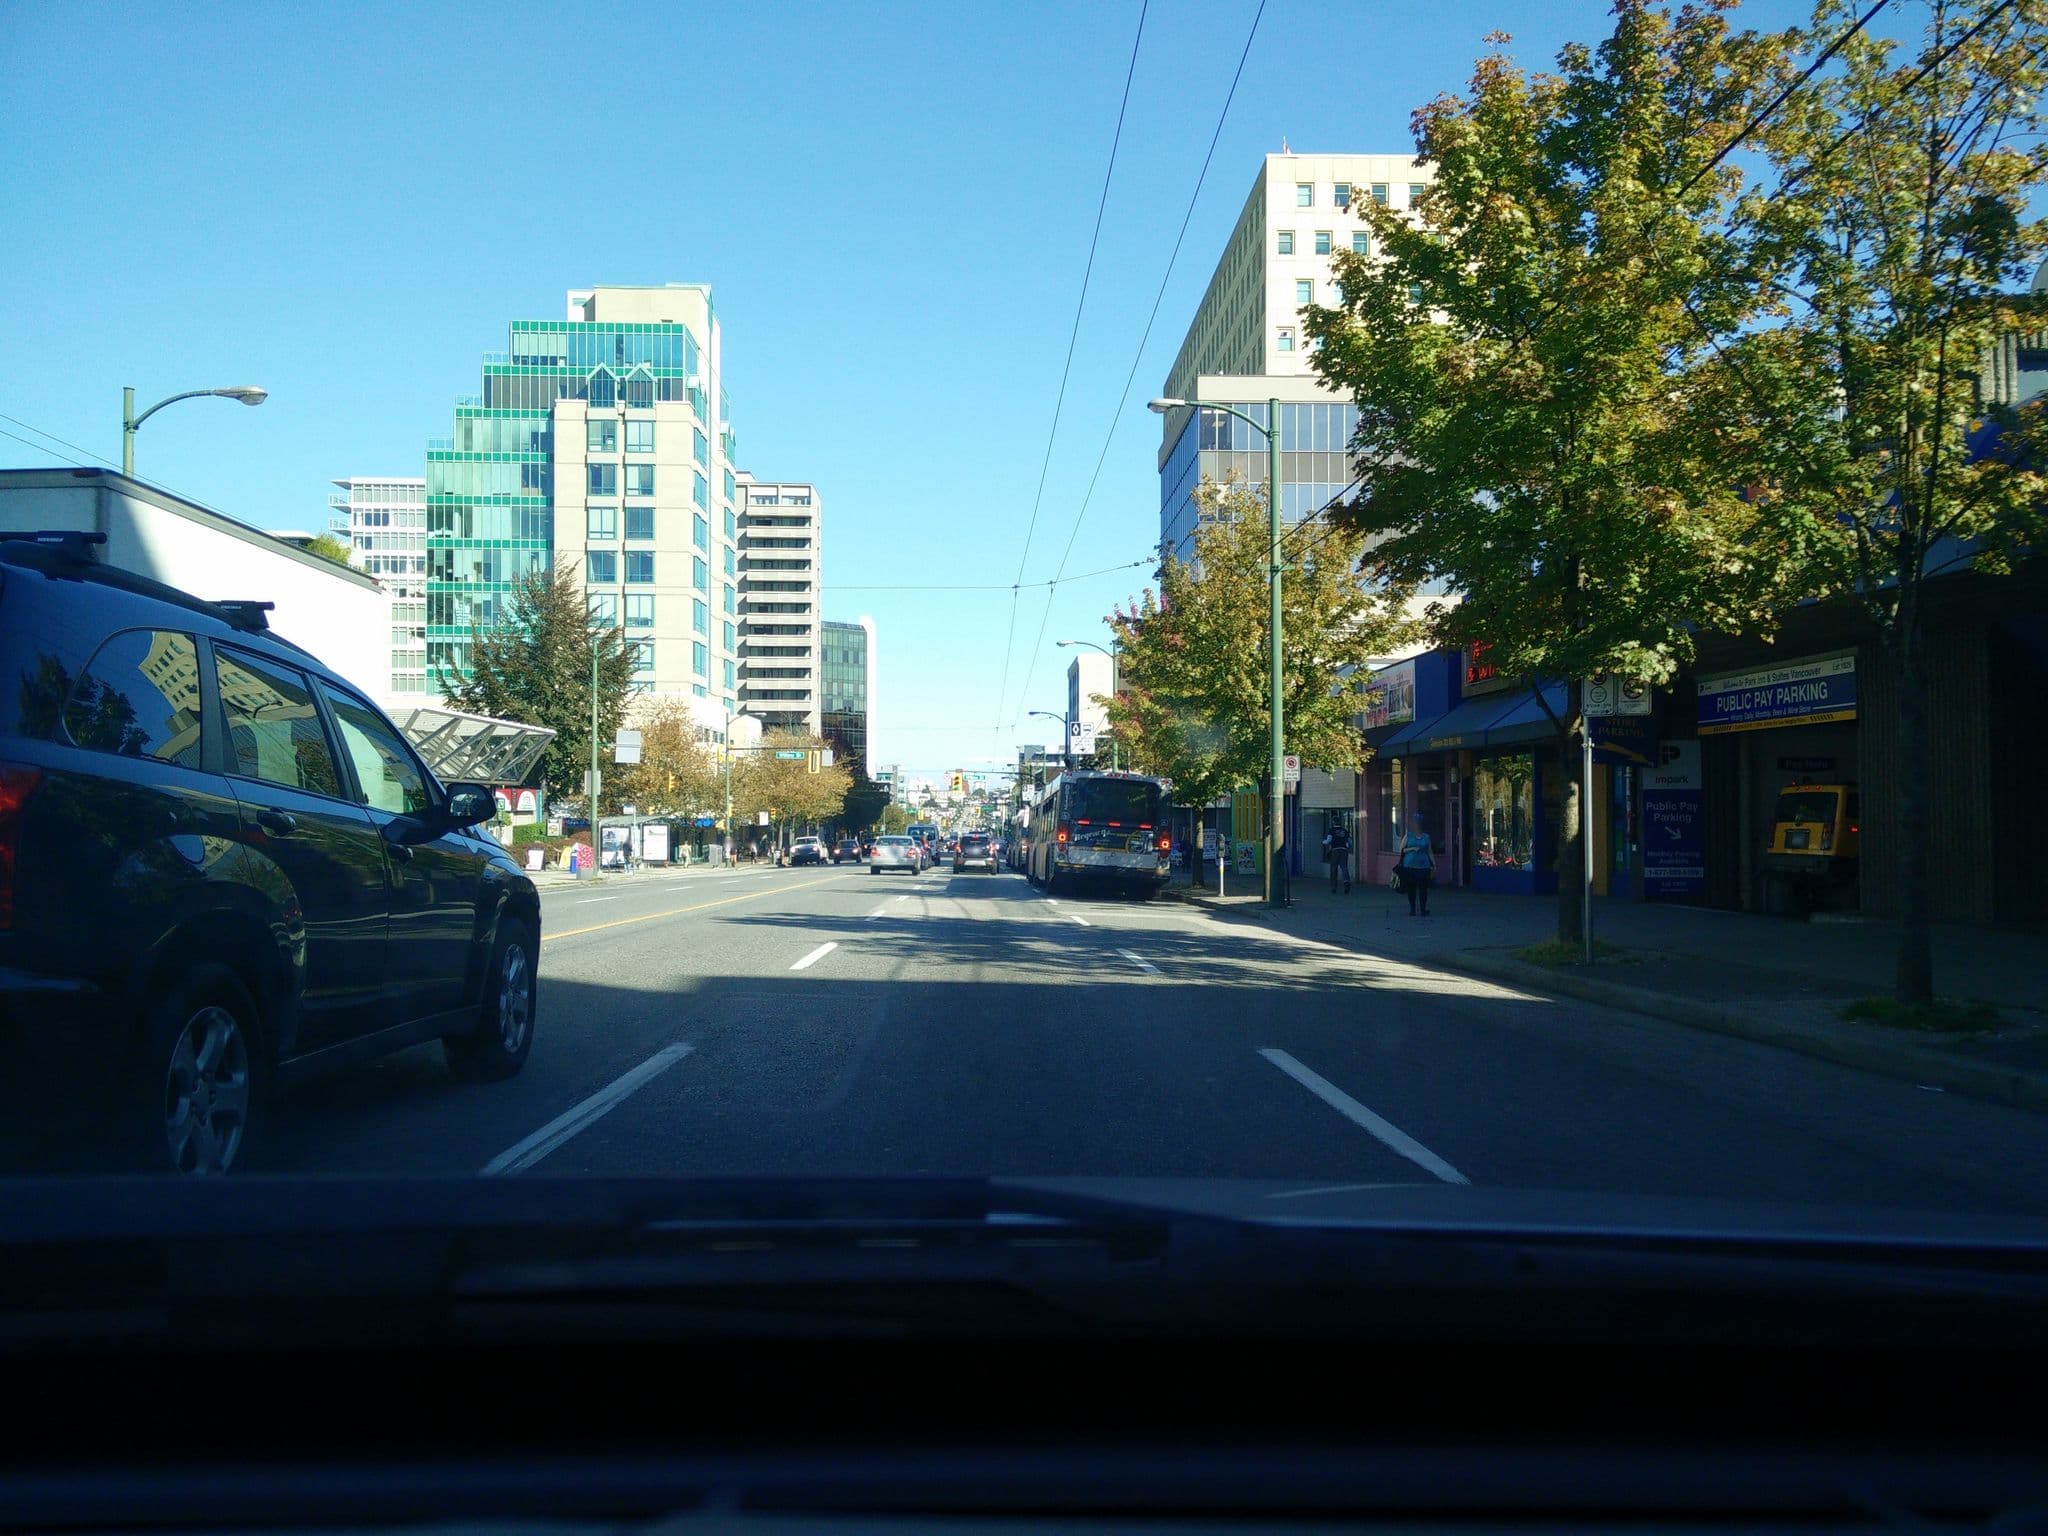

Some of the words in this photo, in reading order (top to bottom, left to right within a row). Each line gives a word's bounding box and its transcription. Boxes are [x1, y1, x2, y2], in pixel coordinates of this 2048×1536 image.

[1791, 667, 1821, 681] Vancouver
[1716, 693, 1752, 713] PUBLIC
[1754, 688, 1774, 708] PAY
[1776, 682, 1828, 704] PARKING
[1655, 775, 1689, 786] impark
[1646, 801, 1678, 811] Public
[1679, 801, 1698, 813] Pay
[1653, 812, 1692, 824] Parking
